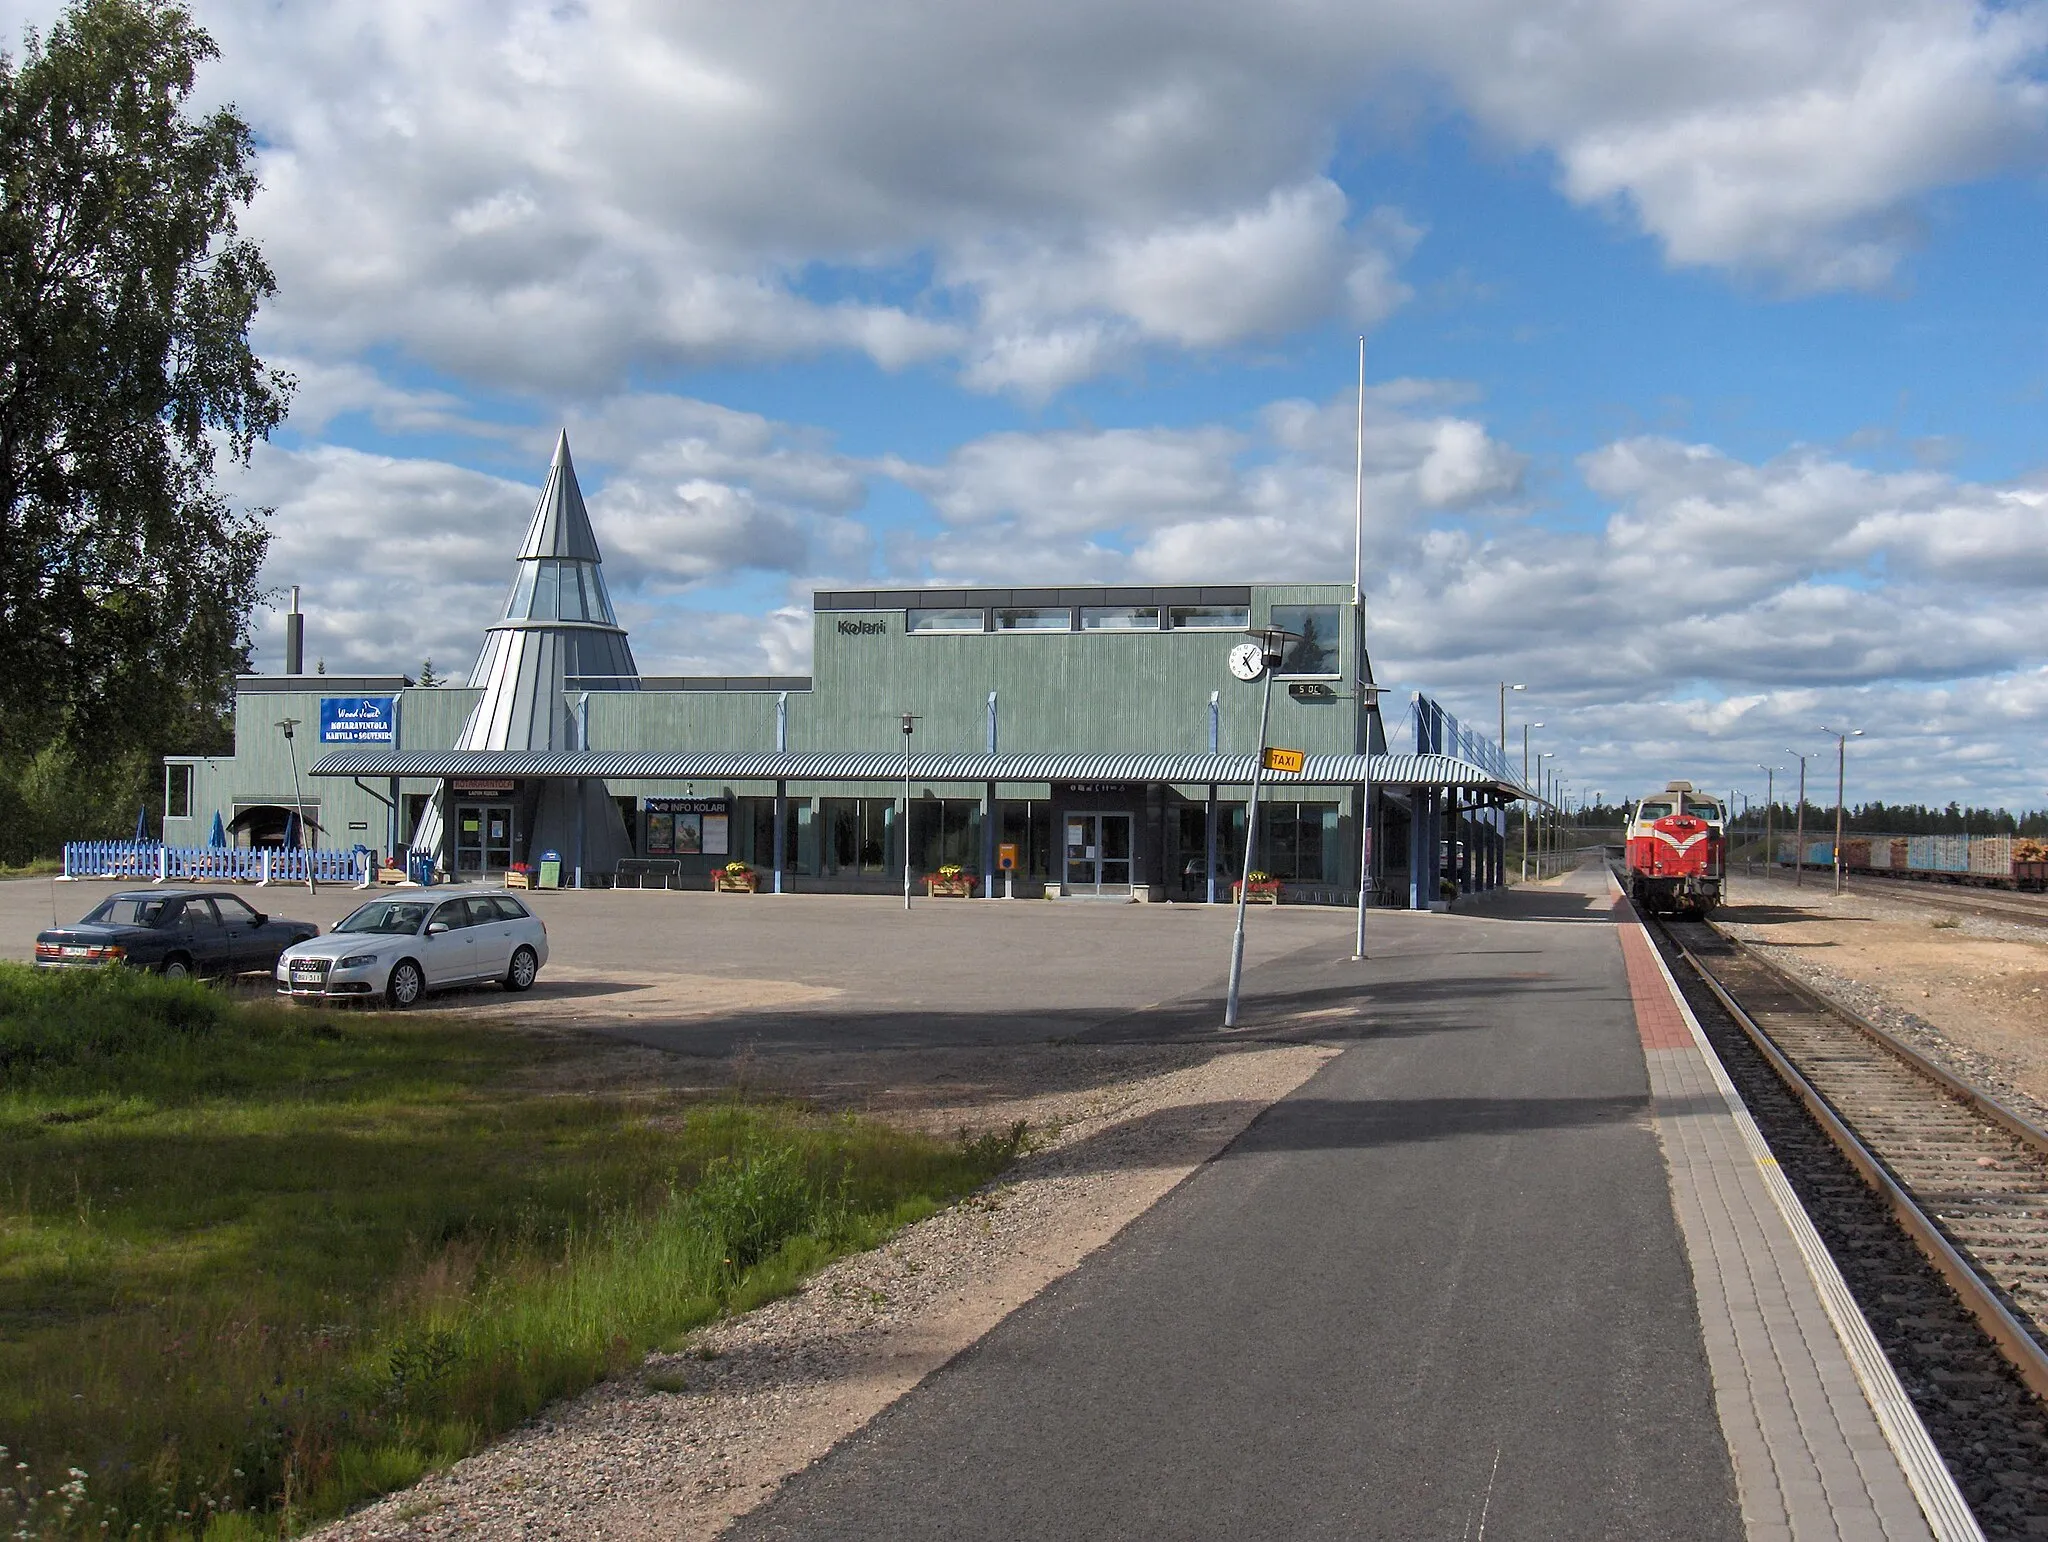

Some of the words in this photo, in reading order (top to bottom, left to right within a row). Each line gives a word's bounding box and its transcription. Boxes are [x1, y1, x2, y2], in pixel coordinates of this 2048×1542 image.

[838, 620, 885, 634] Kolari
[338, 708, 359, 718] Wood
[331, 722, 388, 730] KOTARAVINTOLA
[326, 732, 353, 740] KAHVILA
[1273, 754, 1295, 767] TAXI
[671, 803, 691, 812] INFO
[693, 803, 725, 812] KOLARI
